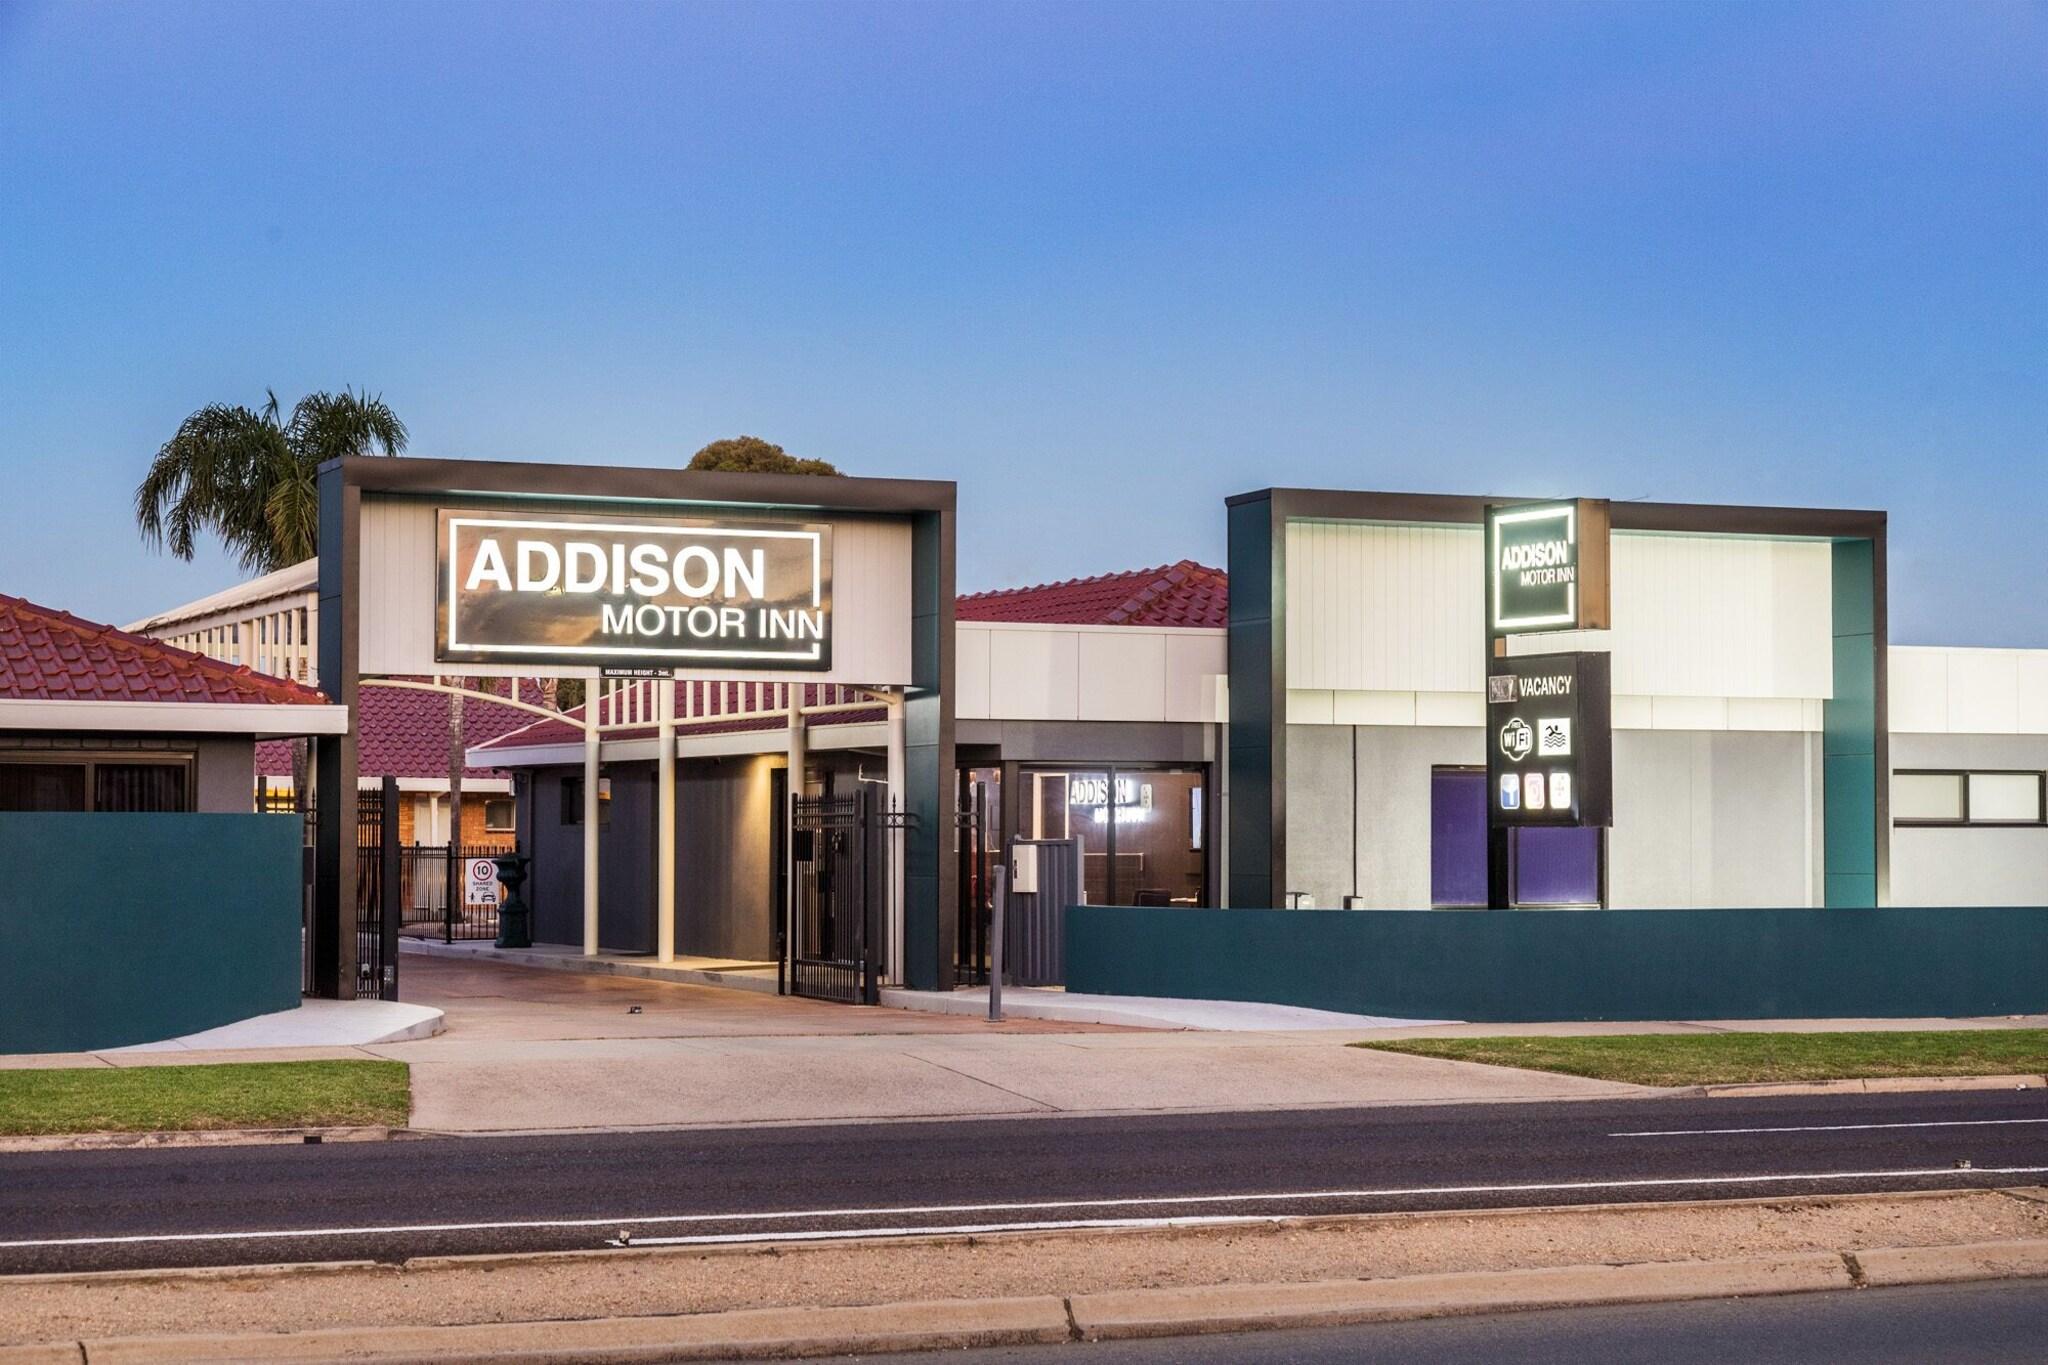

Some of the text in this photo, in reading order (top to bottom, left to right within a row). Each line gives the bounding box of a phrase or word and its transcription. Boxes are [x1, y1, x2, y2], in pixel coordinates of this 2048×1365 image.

[1502, 540, 1568, 570] ADDISON
[465, 539, 764, 599] ADDISON
[1520, 566, 1575, 587] MOTOR INN
[602, 604, 823, 640] MOTOR INN
[1519, 675, 1572, 697] VACANCY
[1070, 779, 1127, 804] ADDISN
[477, 865, 488, 875] 10
